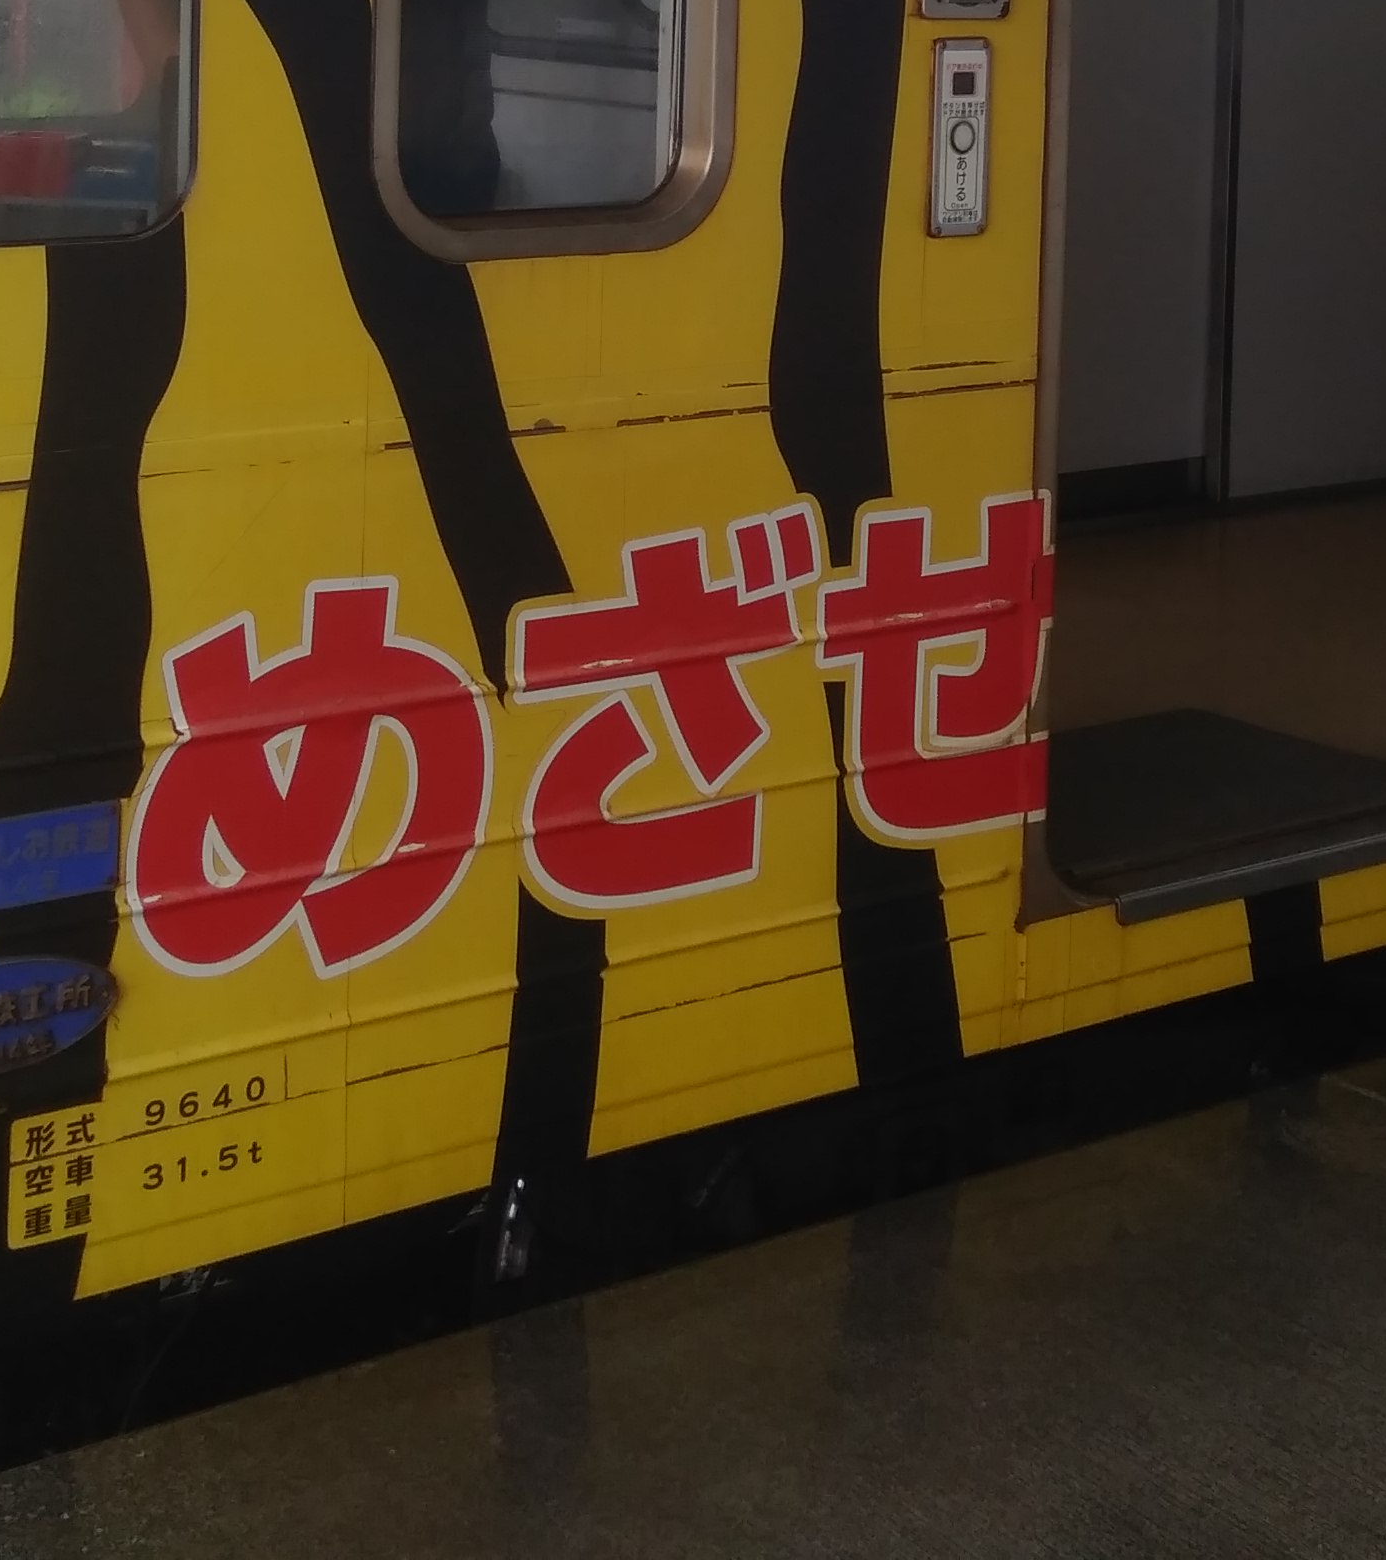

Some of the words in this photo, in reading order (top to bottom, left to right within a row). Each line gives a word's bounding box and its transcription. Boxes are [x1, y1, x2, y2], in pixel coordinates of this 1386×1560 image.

[955, 157, 968, 202] あける
[127, 490, 1056, 980] めざせ
[26, 1114, 96, 1155] 形式
[144, 1074, 266, 1127] 9640
[25, 1155, 95, 1198] 空車
[142, 1140, 264, 1192] 31.5t
[23, 1195, 94, 1240] 重量
